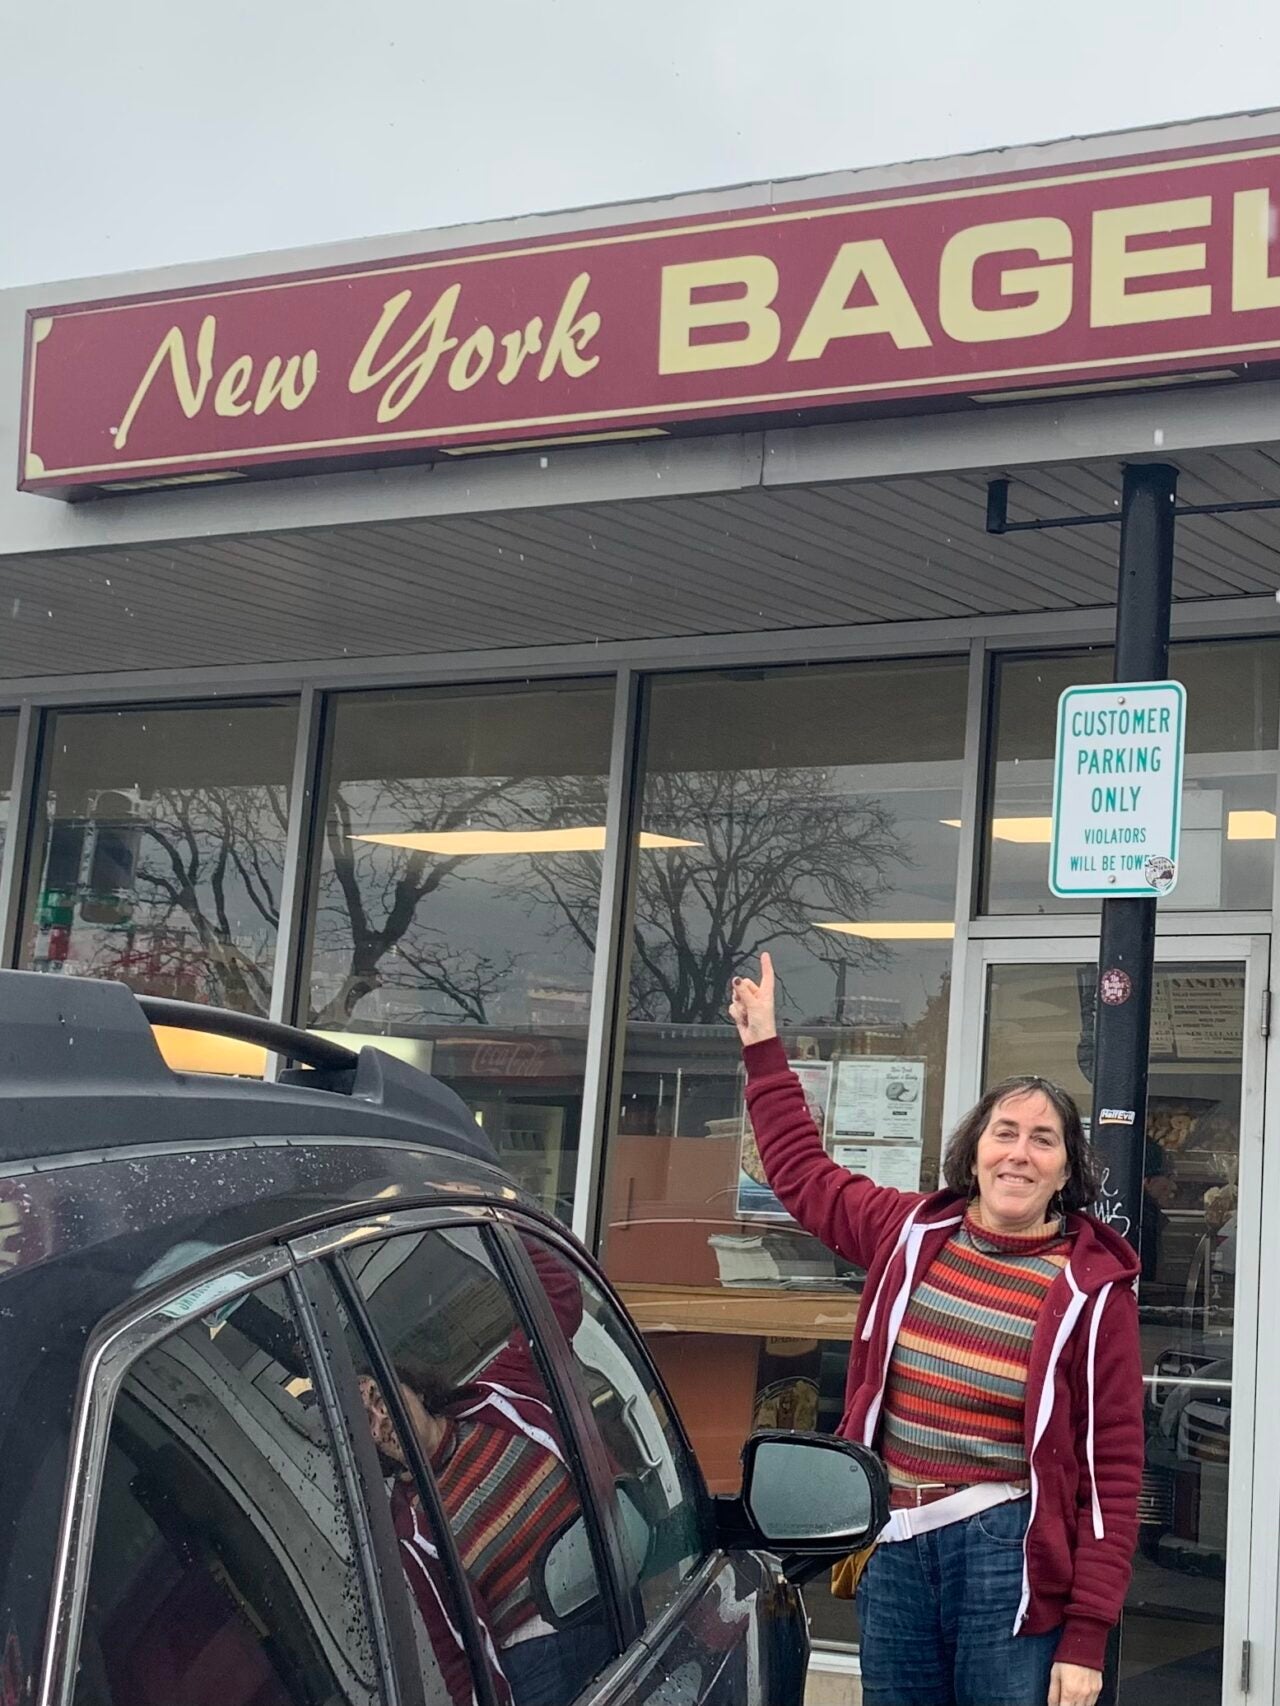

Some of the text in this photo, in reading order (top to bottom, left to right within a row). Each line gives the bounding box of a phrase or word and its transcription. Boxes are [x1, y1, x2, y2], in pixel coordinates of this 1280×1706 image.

[114, 314, 318, 450] New
[348, 271, 601, 423] York
[1071, 707, 1171, 737] CUSTOMER
[1077, 746, 1162, 775] PARKING
[1091, 786, 1142, 812] ONLY
[1084, 827, 1147, 844] VIOLATORS
[1070, 855, 1097, 871] WILL
[1102, 854, 1116, 871] BE
